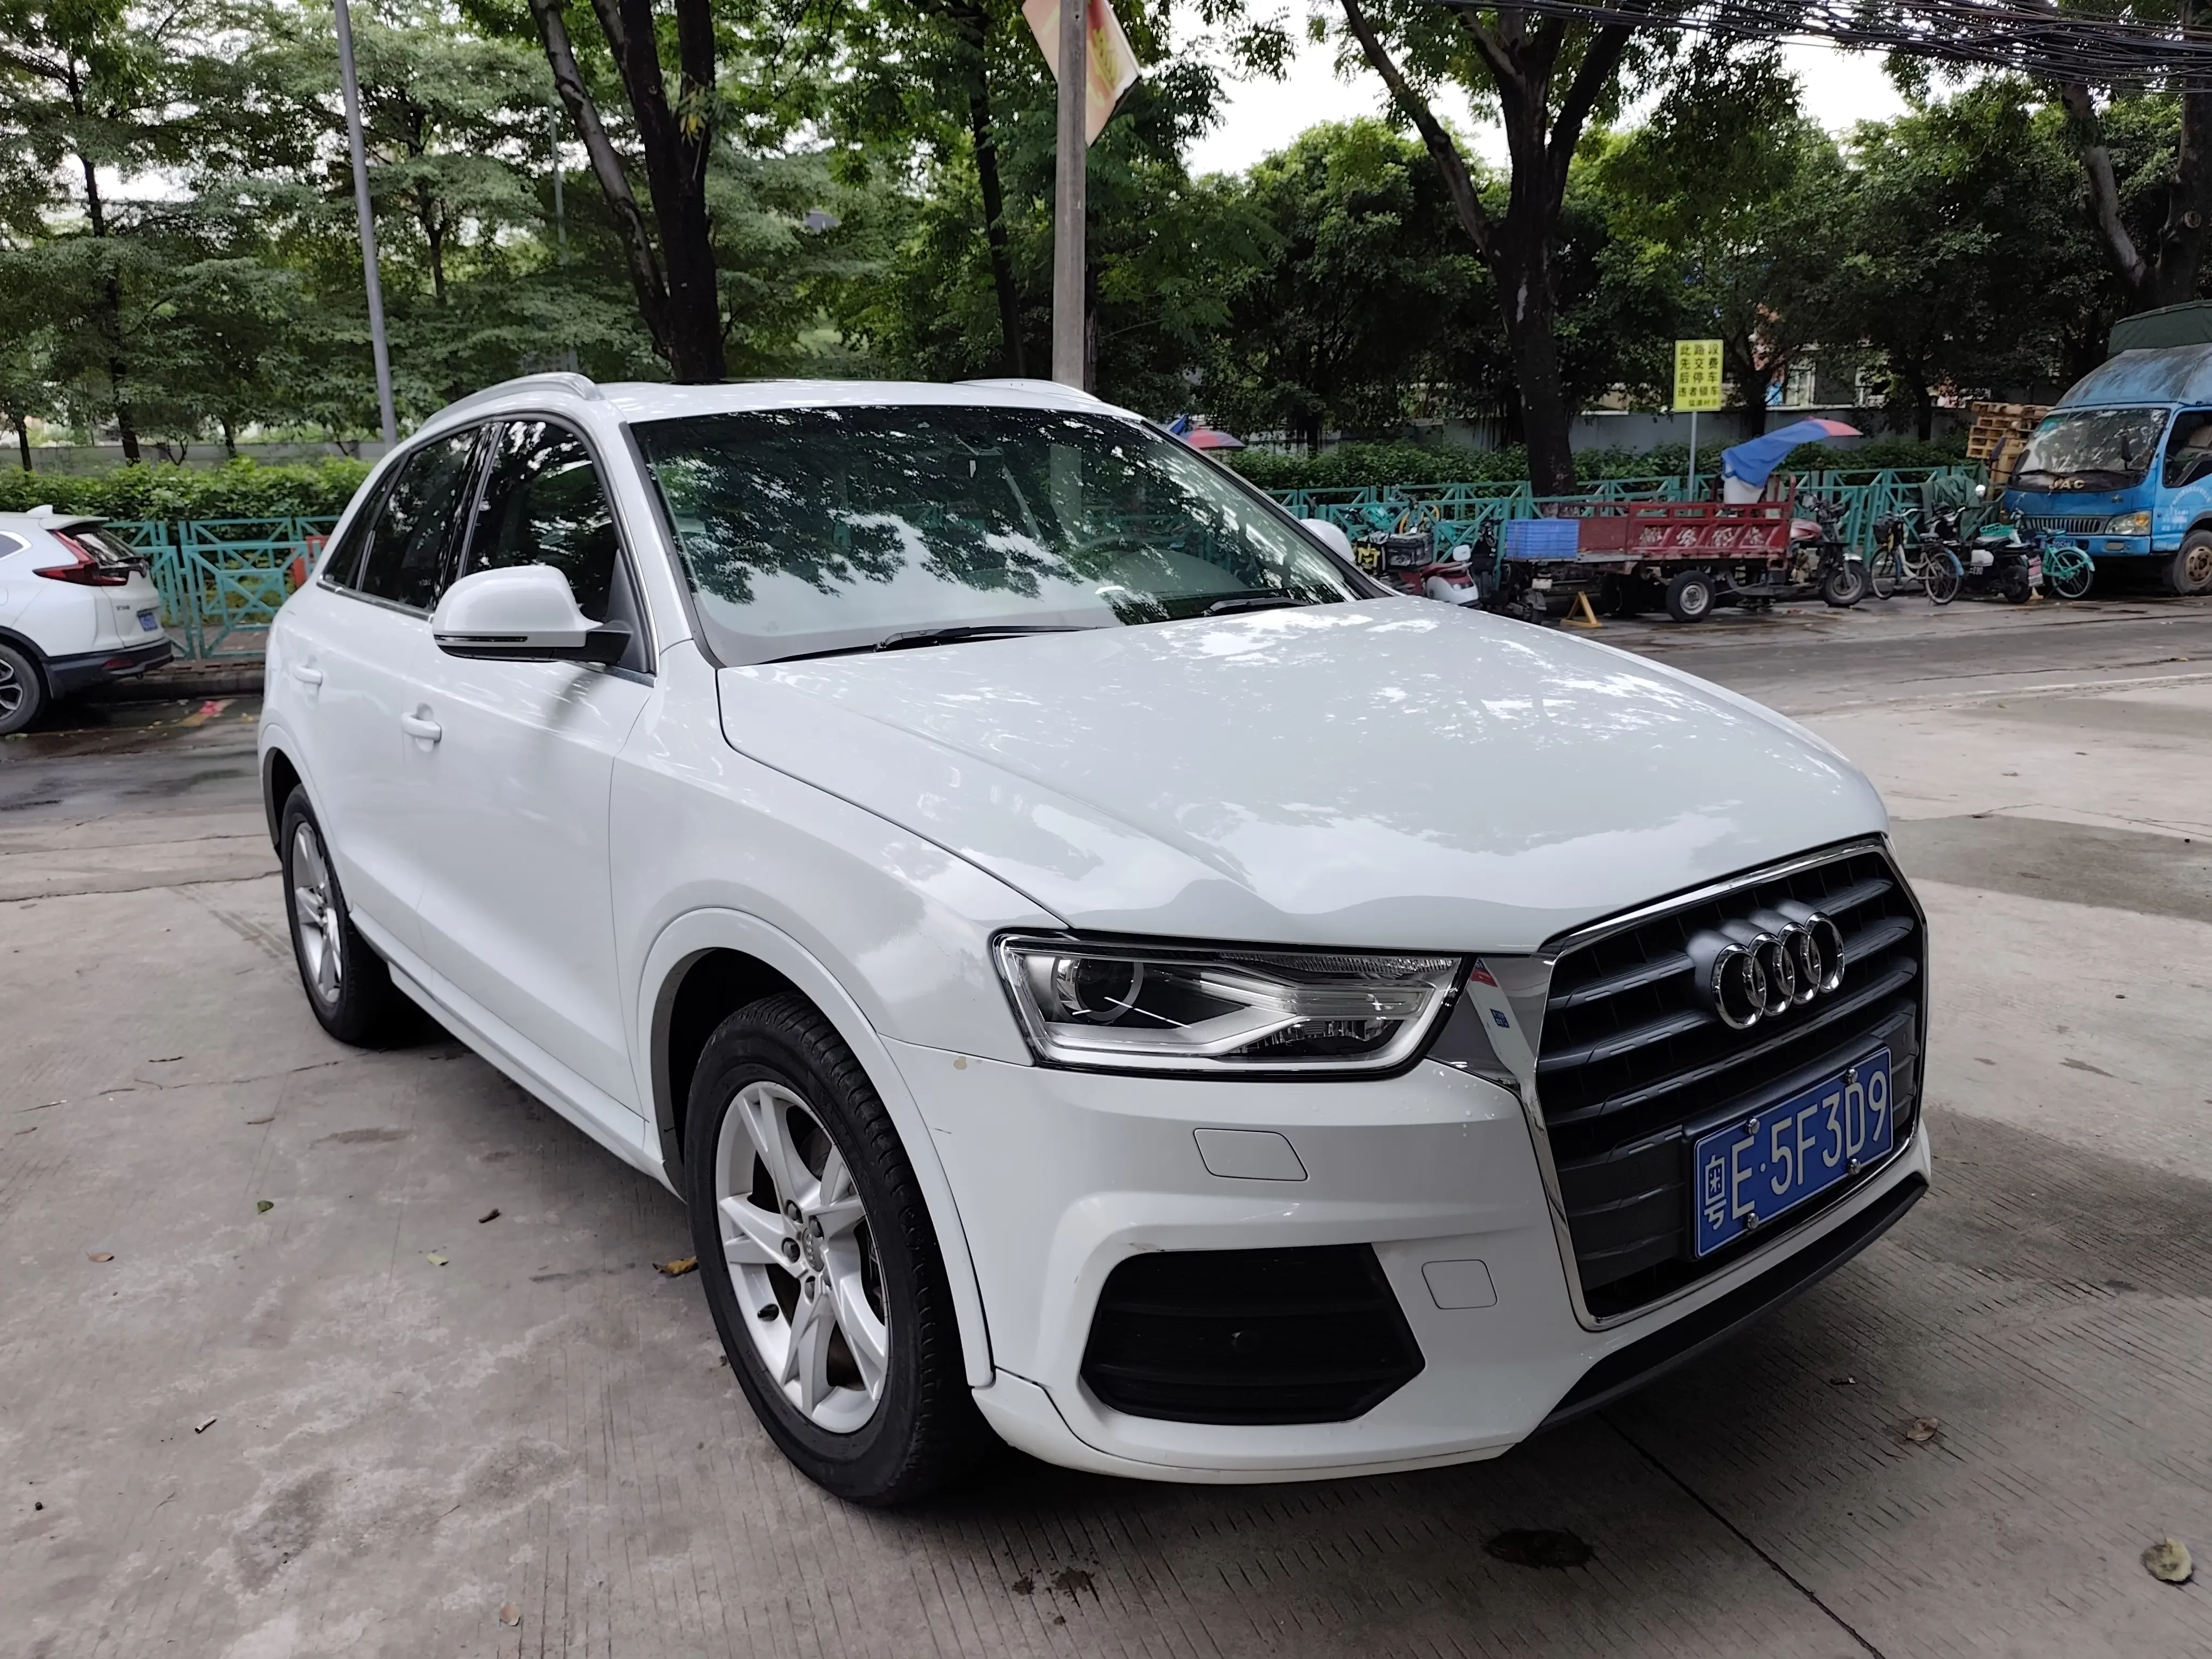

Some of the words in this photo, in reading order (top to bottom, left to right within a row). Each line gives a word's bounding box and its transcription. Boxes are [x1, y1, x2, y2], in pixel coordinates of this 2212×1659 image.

[1680, 343, 1718, 356] 此路段
[1678, 372, 1718, 384] 后停车
[2051, 478, 2085, 489] JAC
